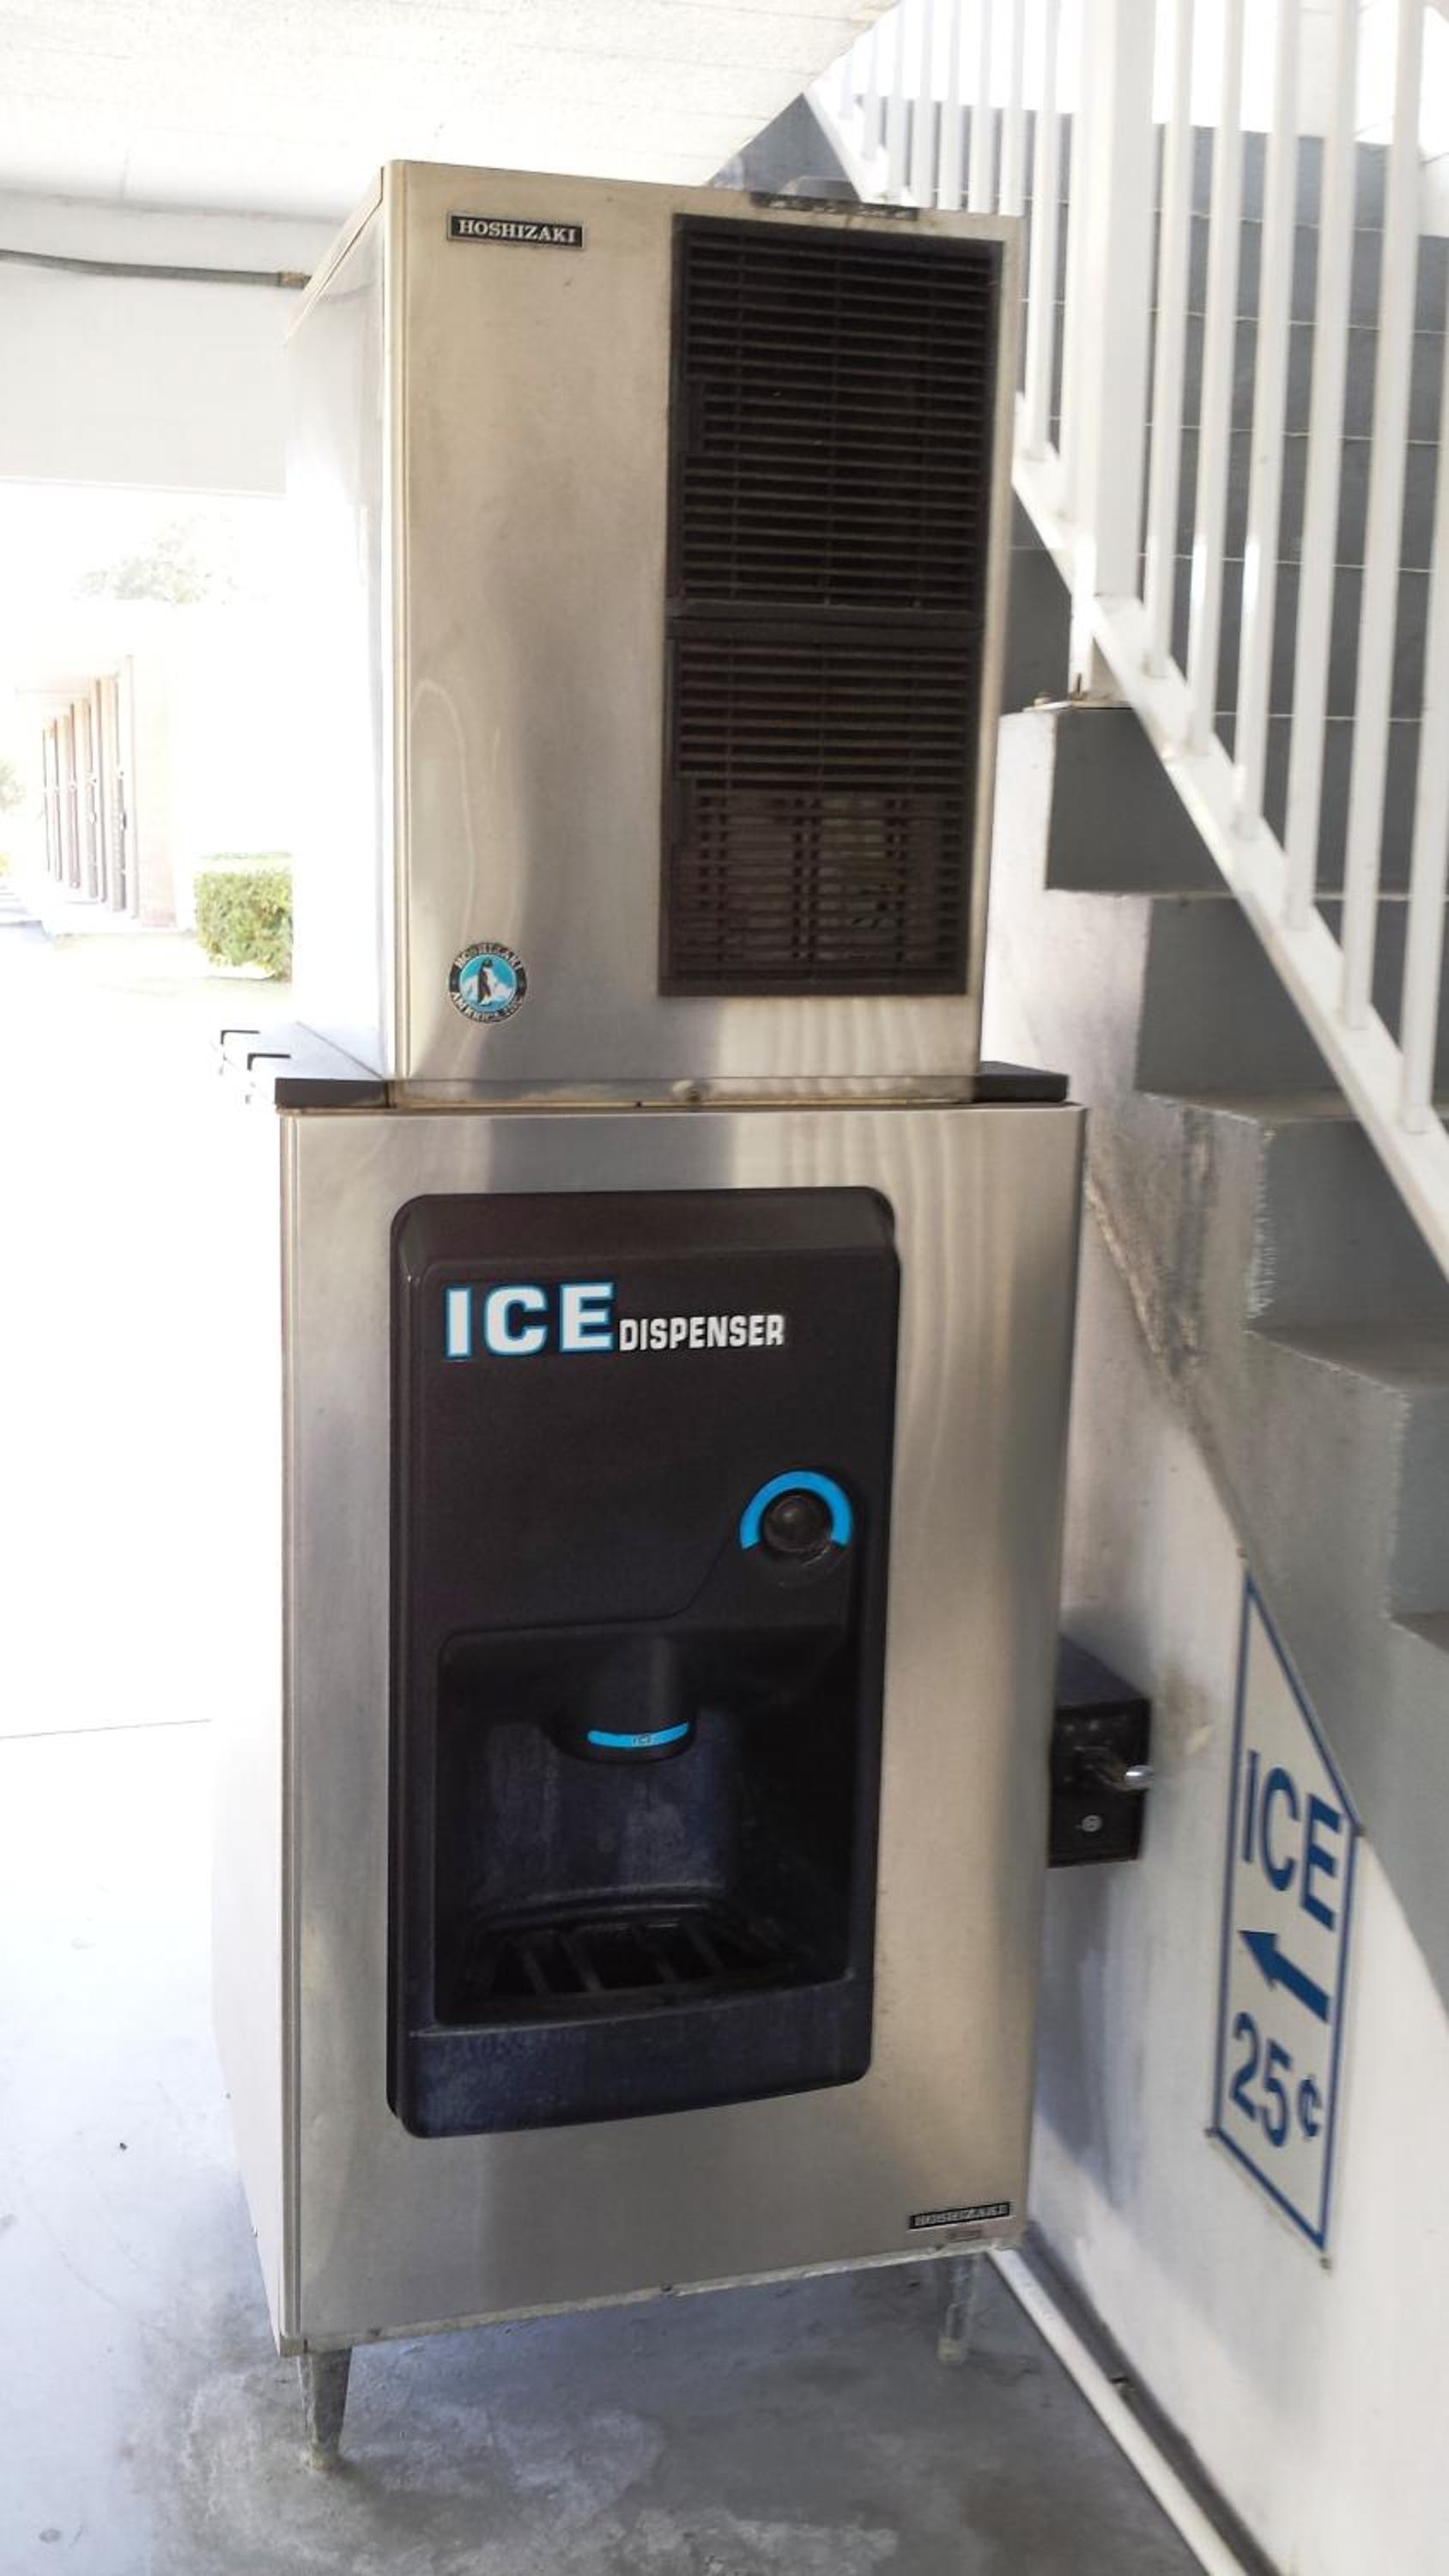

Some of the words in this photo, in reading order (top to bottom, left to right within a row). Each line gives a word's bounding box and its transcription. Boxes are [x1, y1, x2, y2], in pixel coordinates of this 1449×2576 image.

[458, 219, 578, 243] HOSHIZAKI
[446, 1281, 615, 1358] ICE
[618, 1314, 785, 1352] DISPENSER
[1241, 1748, 1342, 1931] ICE
[1228, 2011, 1323, 2148] 25¢
